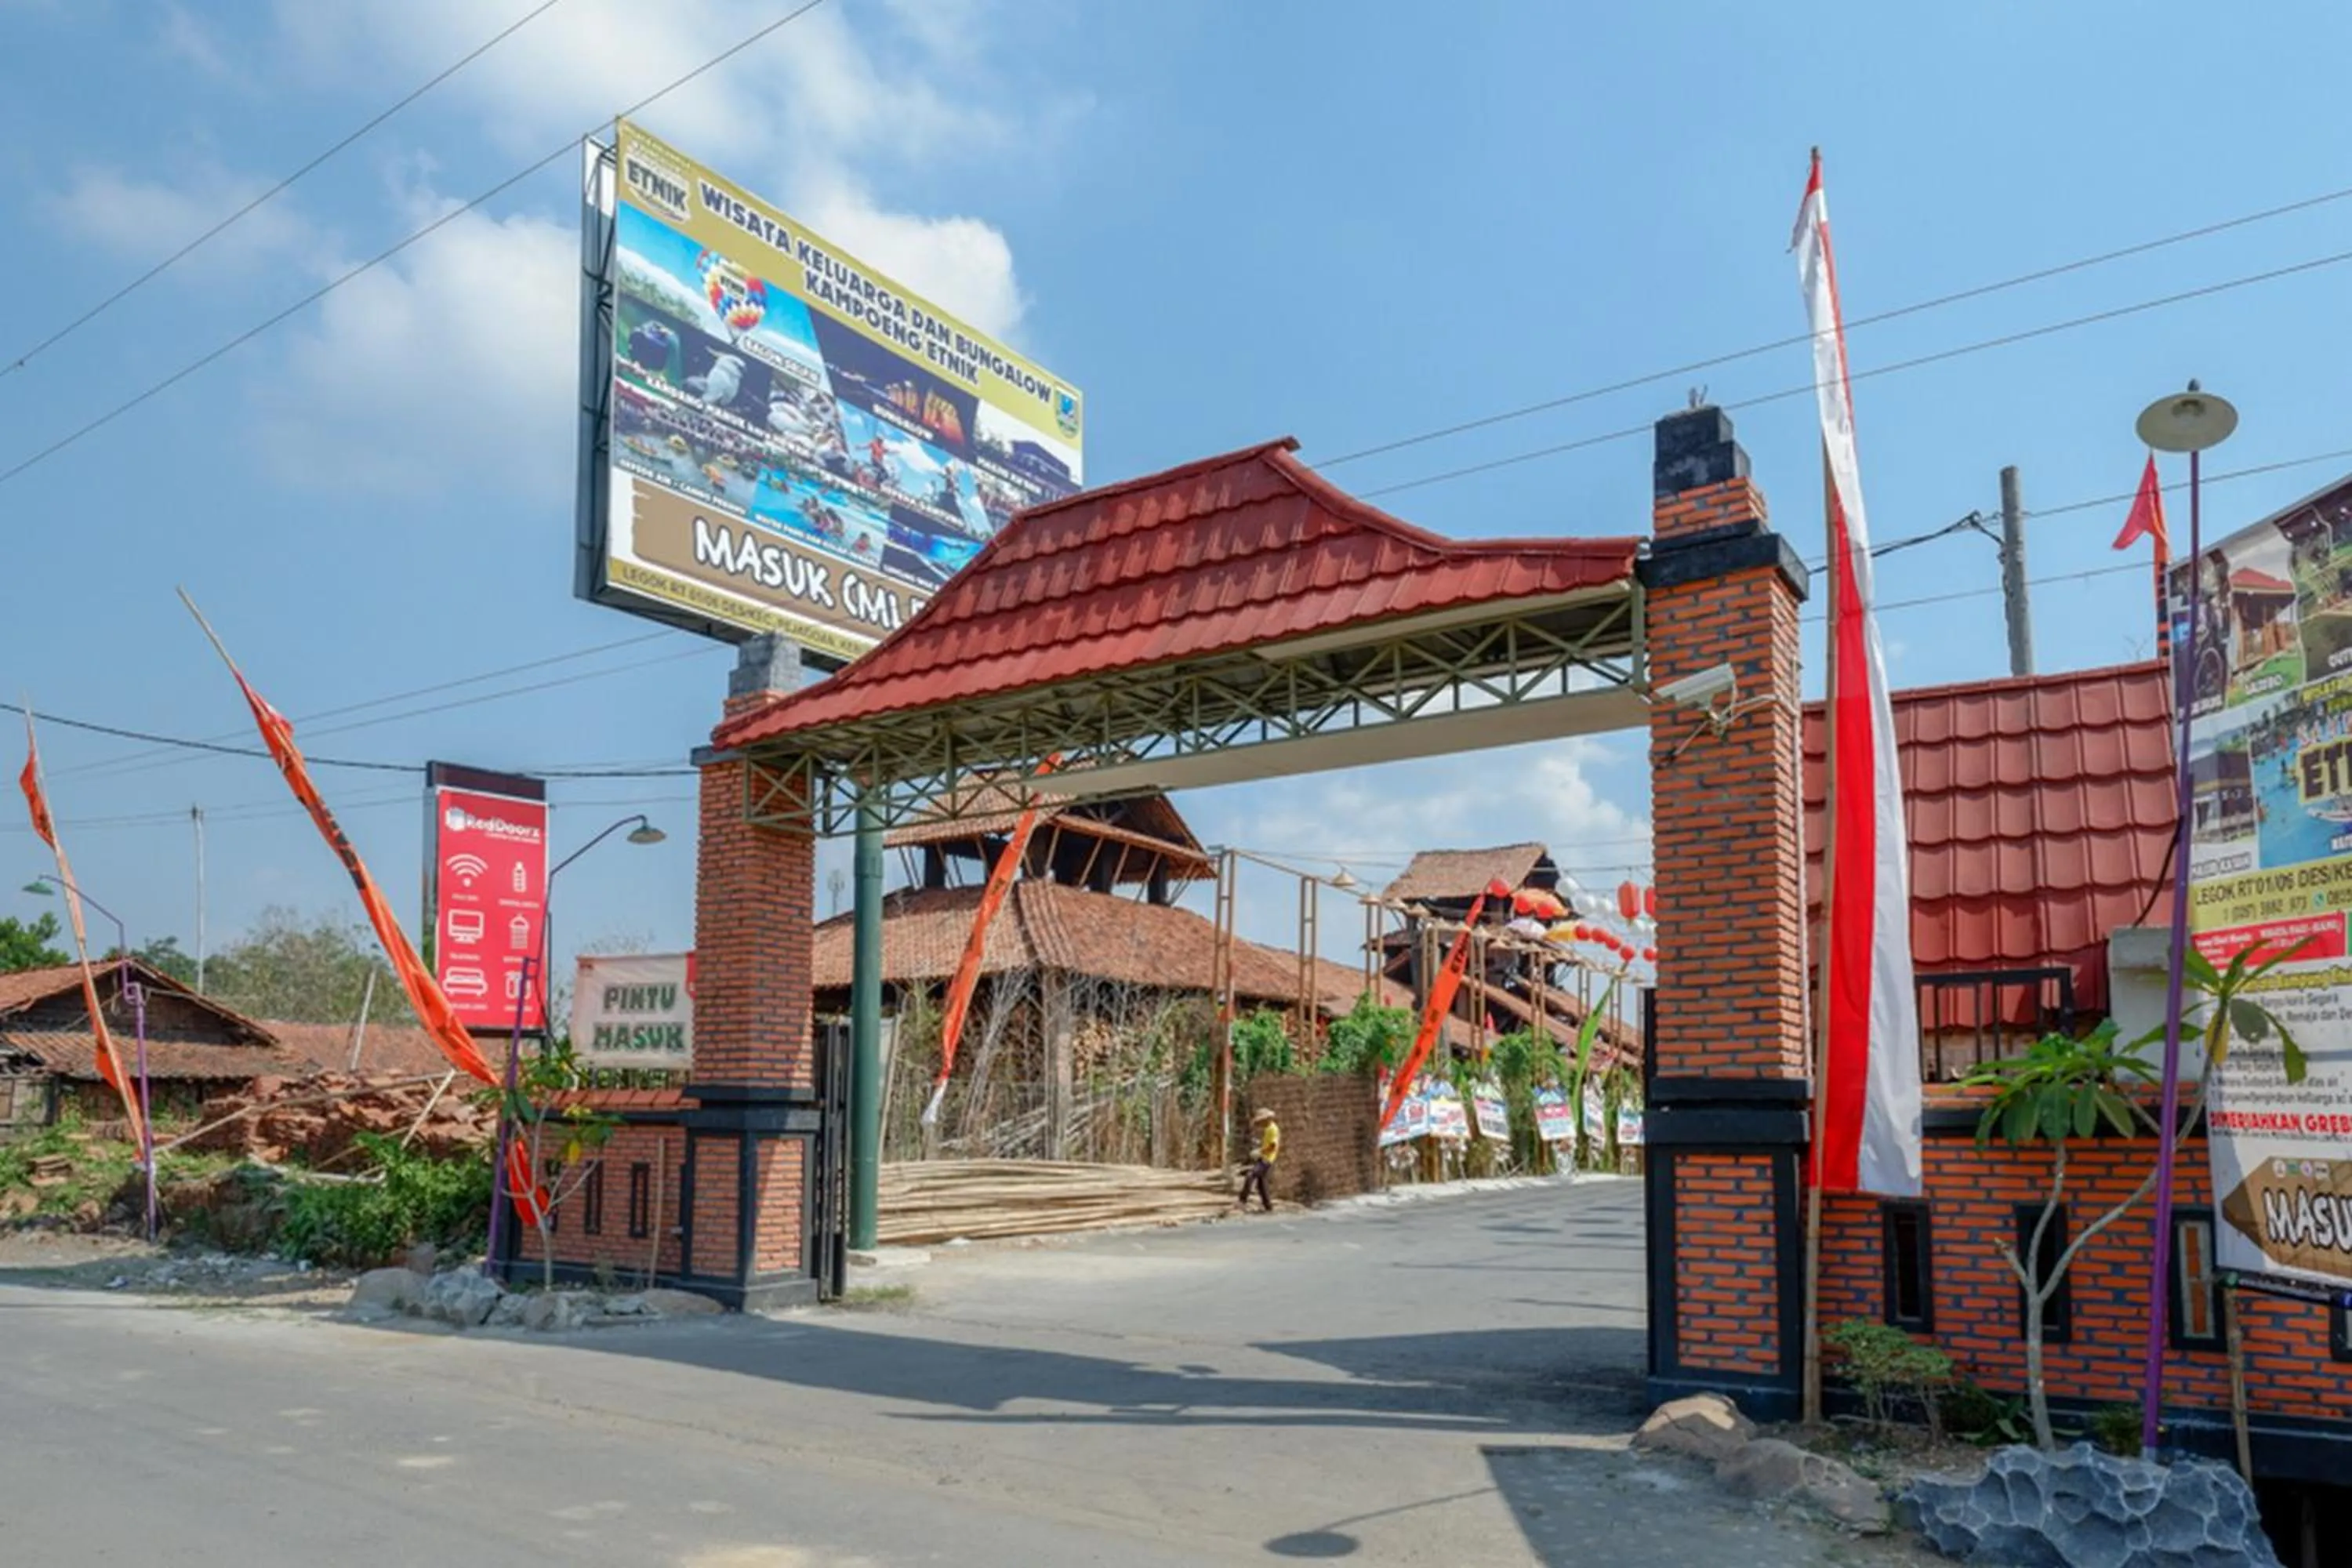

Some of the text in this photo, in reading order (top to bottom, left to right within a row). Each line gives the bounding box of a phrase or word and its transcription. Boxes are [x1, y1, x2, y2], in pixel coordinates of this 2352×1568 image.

[626, 161, 688, 212] ETNIK
[699, 180, 1053, 405] WISATA KELUARGA DAN BUNGALOW
[804, 270, 980, 386] KAMPOENG ETNIK
[694, 517, 835, 609] MASUK
[2301, 740, 2352, 800] ET
[2195, 885, 2235, 906] LEGOK
[603, 984, 677, 1013] PINTU
[593, 1022, 686, 1052] MASUK
[2305, 1112, 2352, 1133] GREB
